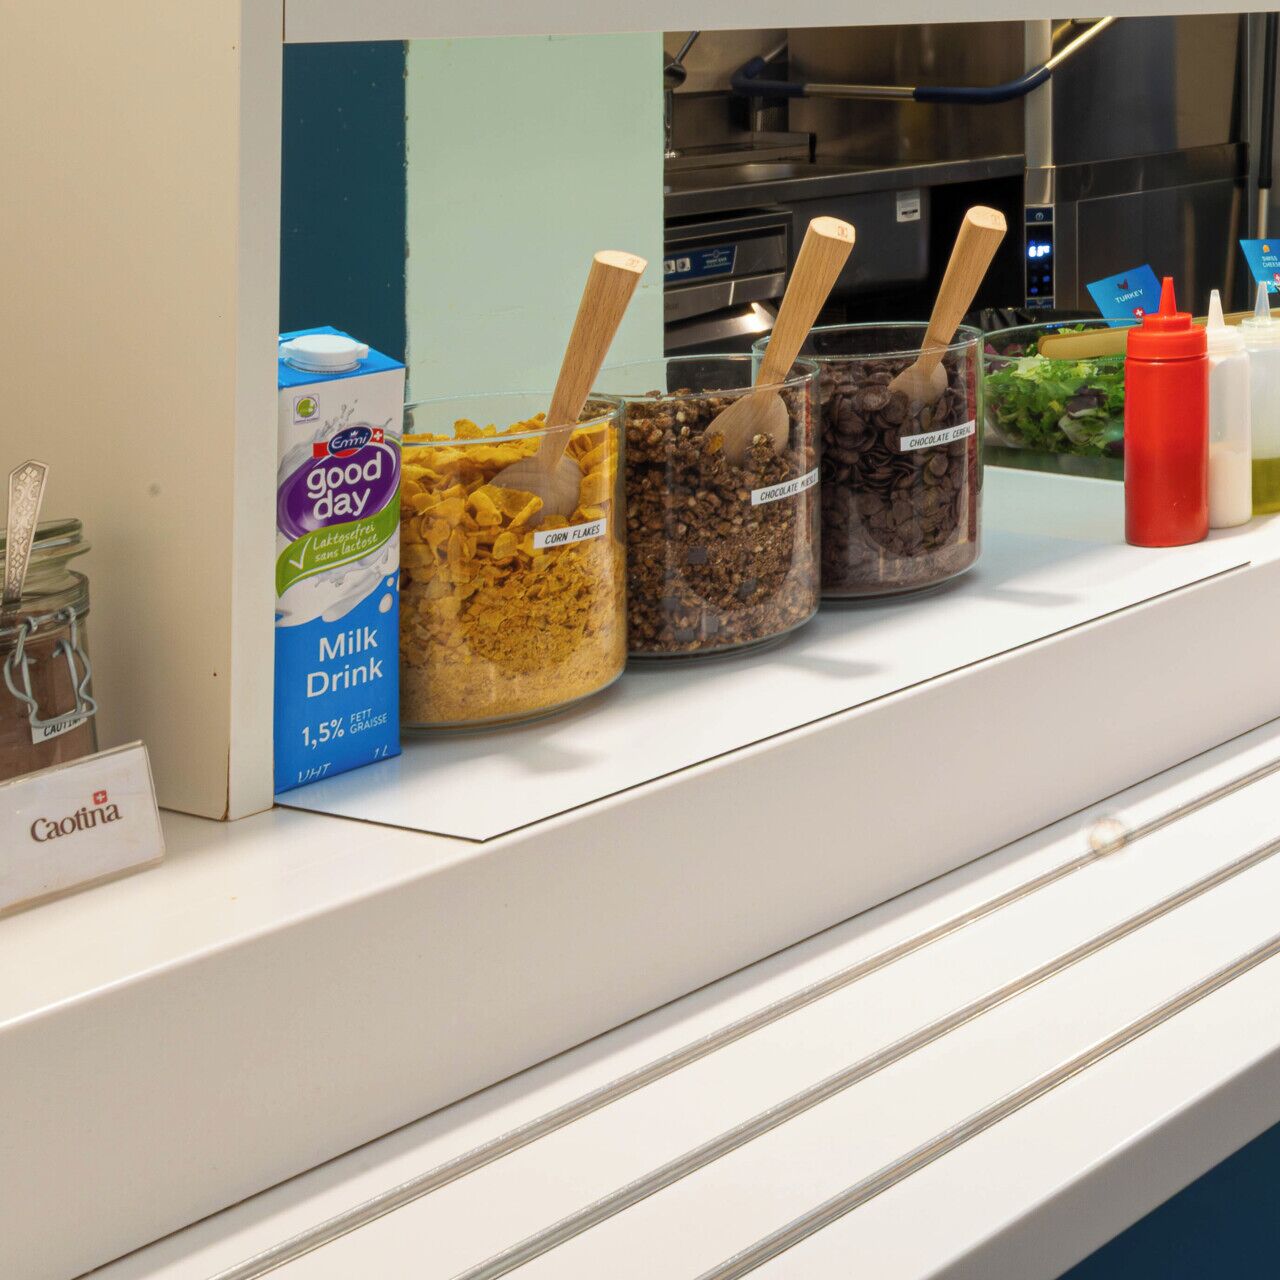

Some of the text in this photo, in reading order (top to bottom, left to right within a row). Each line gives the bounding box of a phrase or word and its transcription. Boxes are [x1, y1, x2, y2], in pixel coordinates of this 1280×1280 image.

[1115, 288, 1144, 304] TURKEY
[331, 432, 369, 449] Emmi
[909, 426, 972, 448] CHOCOLATE CEREAL
[306, 451, 382, 499] good
[313, 488, 371, 520] day
[760, 482, 799, 501] CHOCOLATE
[313, 521, 375, 551] Laktosefrei
[545, 524, 600, 545] CORN FLAKES
[314, 533, 378, 563] sans lactose
[319, 626, 379, 663] Milk
[306, 657, 384, 698] Drink
[350, 708, 373, 724] FETT
[350, 712, 388, 735] GRAISSE
[301, 717, 345, 750] 1,5%
[298, 762, 332, 783] UHT
[30, 803, 123, 843] Caotina
